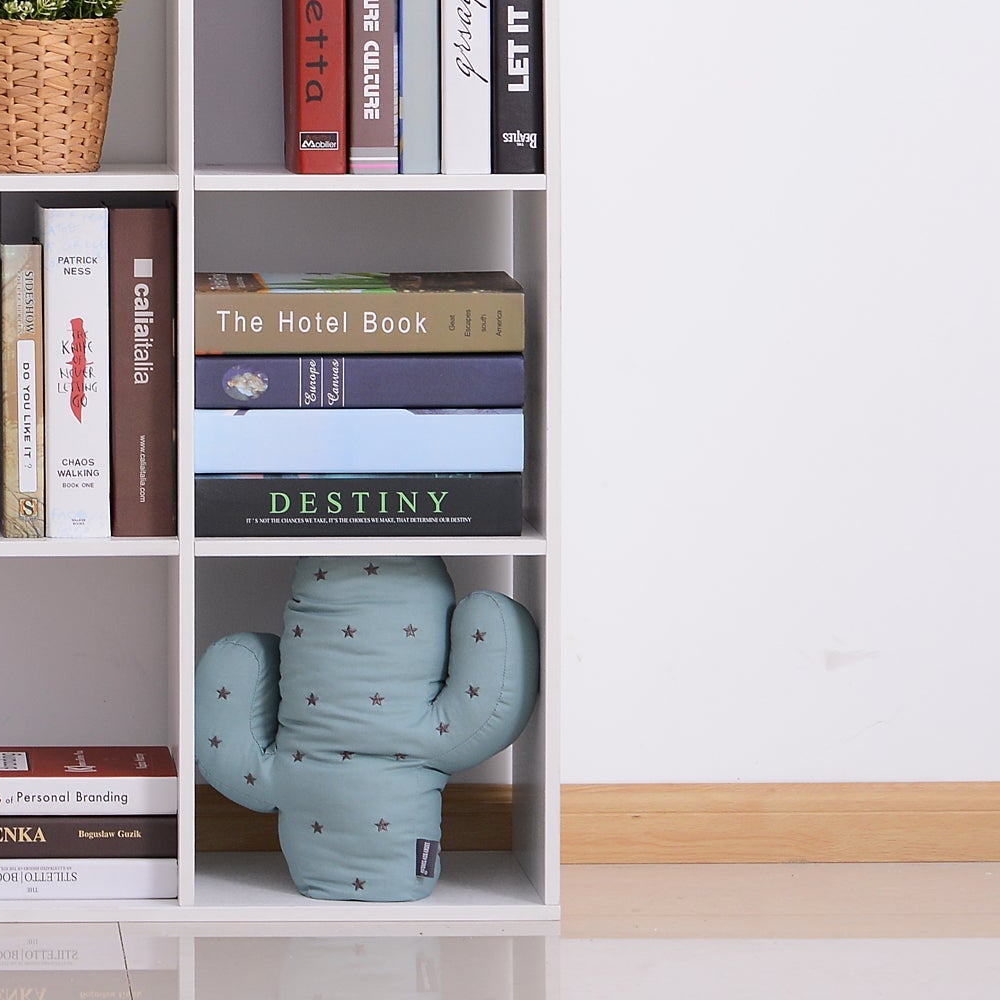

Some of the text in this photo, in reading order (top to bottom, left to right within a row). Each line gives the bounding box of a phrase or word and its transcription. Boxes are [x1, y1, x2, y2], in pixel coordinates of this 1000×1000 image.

[507, 5, 530, 33] IT
[507, 39, 530, 92] LET
[363, 40, 380, 120] CULTURE
[57, 256, 98, 265] PATRICK
[63, 267, 92, 276] NESS
[24, 271, 34, 334] SIDESHOW
[134, 282, 154, 385] caliaitalia
[216, 310, 428, 334] The Hotel Book
[22, 362, 30, 380] DO
[304, 358, 318, 406] Europe
[328, 358, 339, 406] Canvas
[23, 385, 31, 410] YOU
[72, 393, 88, 408] GO
[23, 414, 31, 442] LIKE
[24, 447, 32, 459] IT
[61, 458, 95, 467] CHAOS
[57, 469, 100, 478] WALKING
[268, 490, 450, 515] DESTINY
[5, 796, 14, 804] of
[16, 791, 70, 803] Personal
[76, 791, 128, 805] Branding
[117, 829, 142, 838] Guzik
[24, 872, 78, 882] STILETTO
